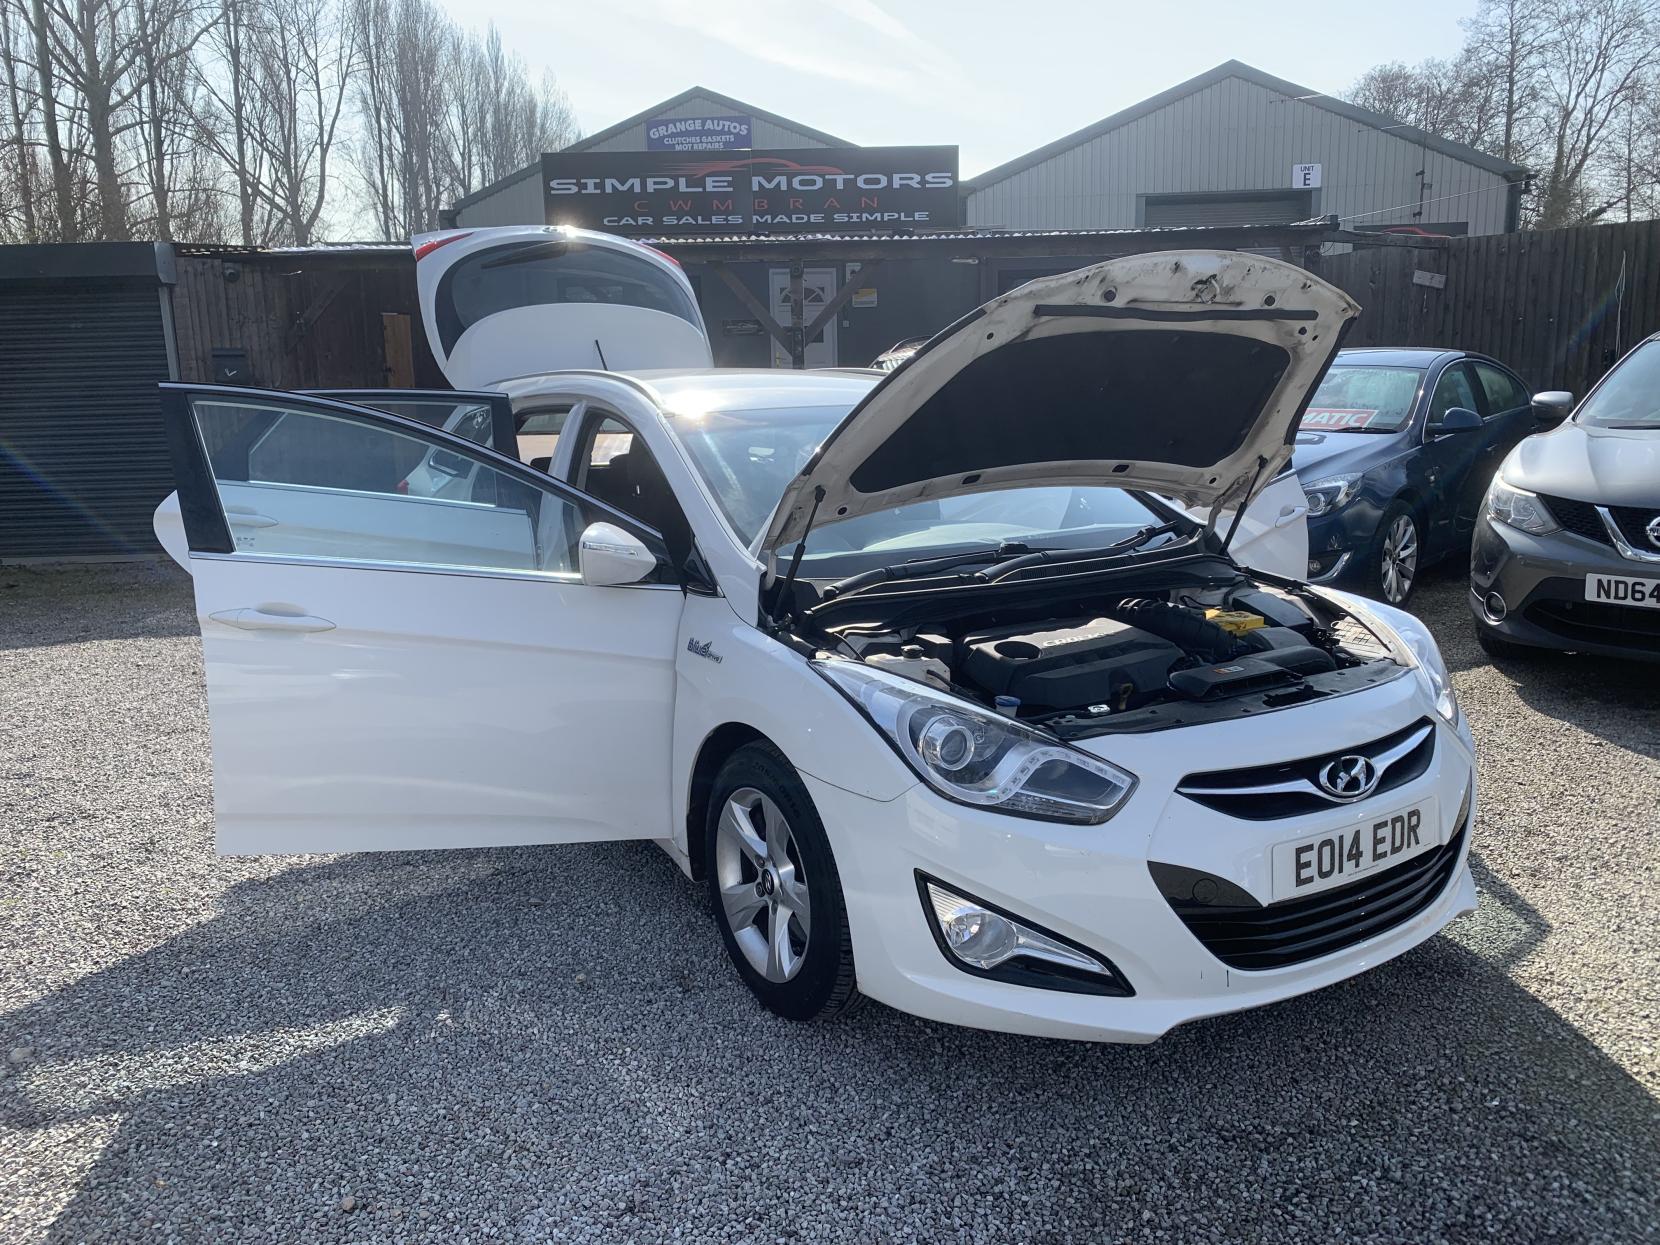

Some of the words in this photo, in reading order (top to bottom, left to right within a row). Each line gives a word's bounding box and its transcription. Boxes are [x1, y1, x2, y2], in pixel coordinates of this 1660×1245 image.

[649, 120, 703, 139] GRANGE
[704, 119, 749, 135] AUTOS
[664, 137, 701, 145] CLUTCHES
[702, 134, 735, 143] GASKETS
[693, 142, 724, 150] REPAIRS
[550, 176, 734, 194] SIMPLE
[752, 172, 953, 192] MOTORS
[1303, 172, 1311, 186] E
[634, 197, 878, 211] CWMBRAN
[603, 217, 653, 226] CAR
[662, 215, 743, 225] SALES
[752, 214, 825, 224] MADE
[833, 212, 930, 222] SIMPLE
[1596, 579, 1660, 603] ND64
[1372, 808, 1421, 862] EDR
